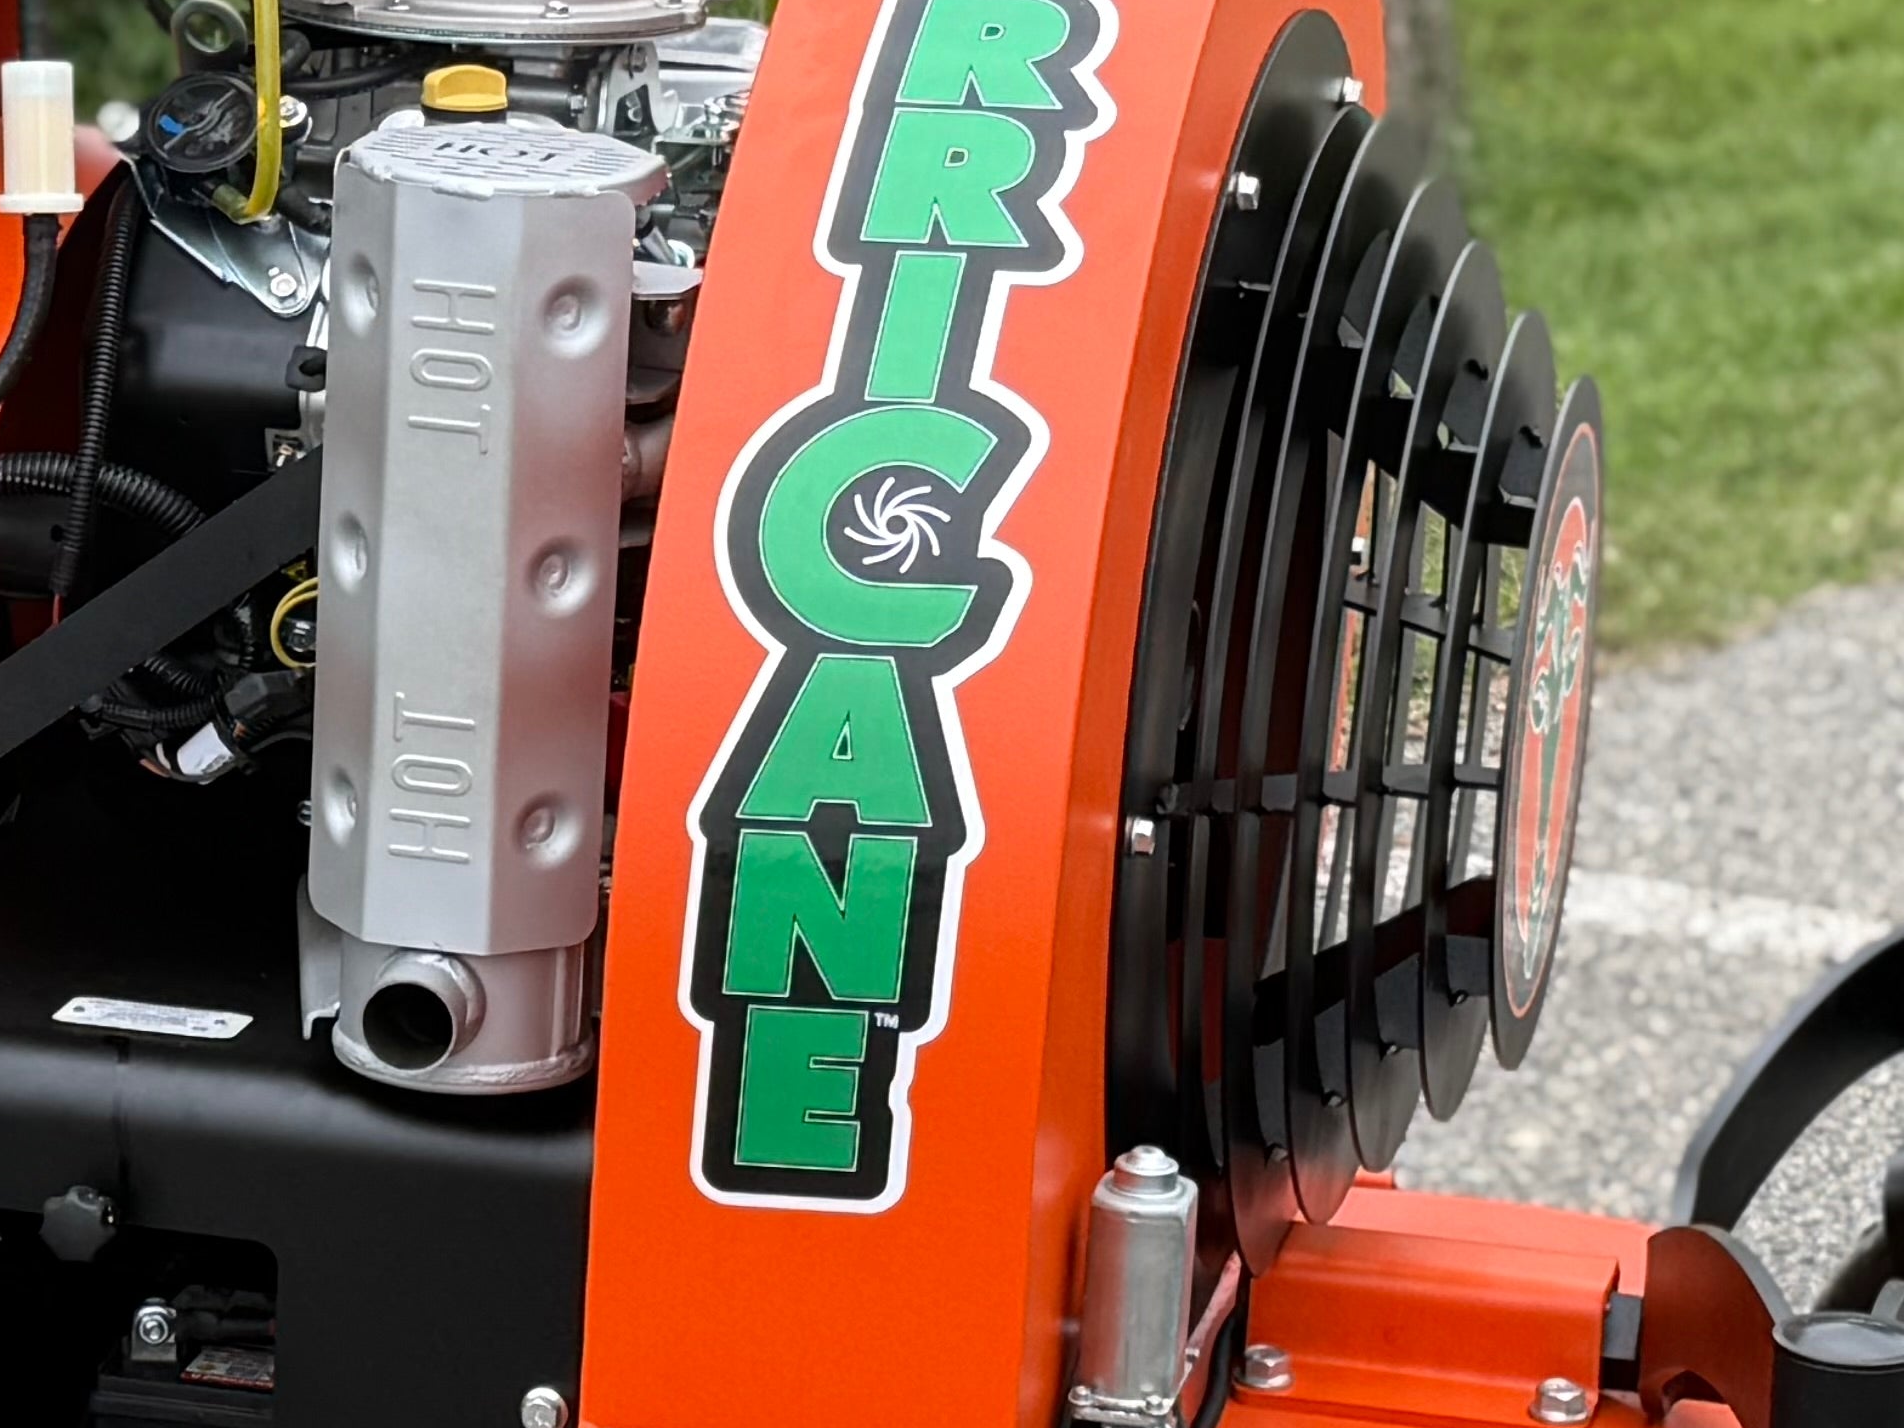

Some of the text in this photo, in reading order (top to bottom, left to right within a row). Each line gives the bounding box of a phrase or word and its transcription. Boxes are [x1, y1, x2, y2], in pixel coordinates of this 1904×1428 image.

[433, 141, 562, 164] HOT
[407, 277, 495, 455] HOT
[388, 689, 476, 865] HOT
